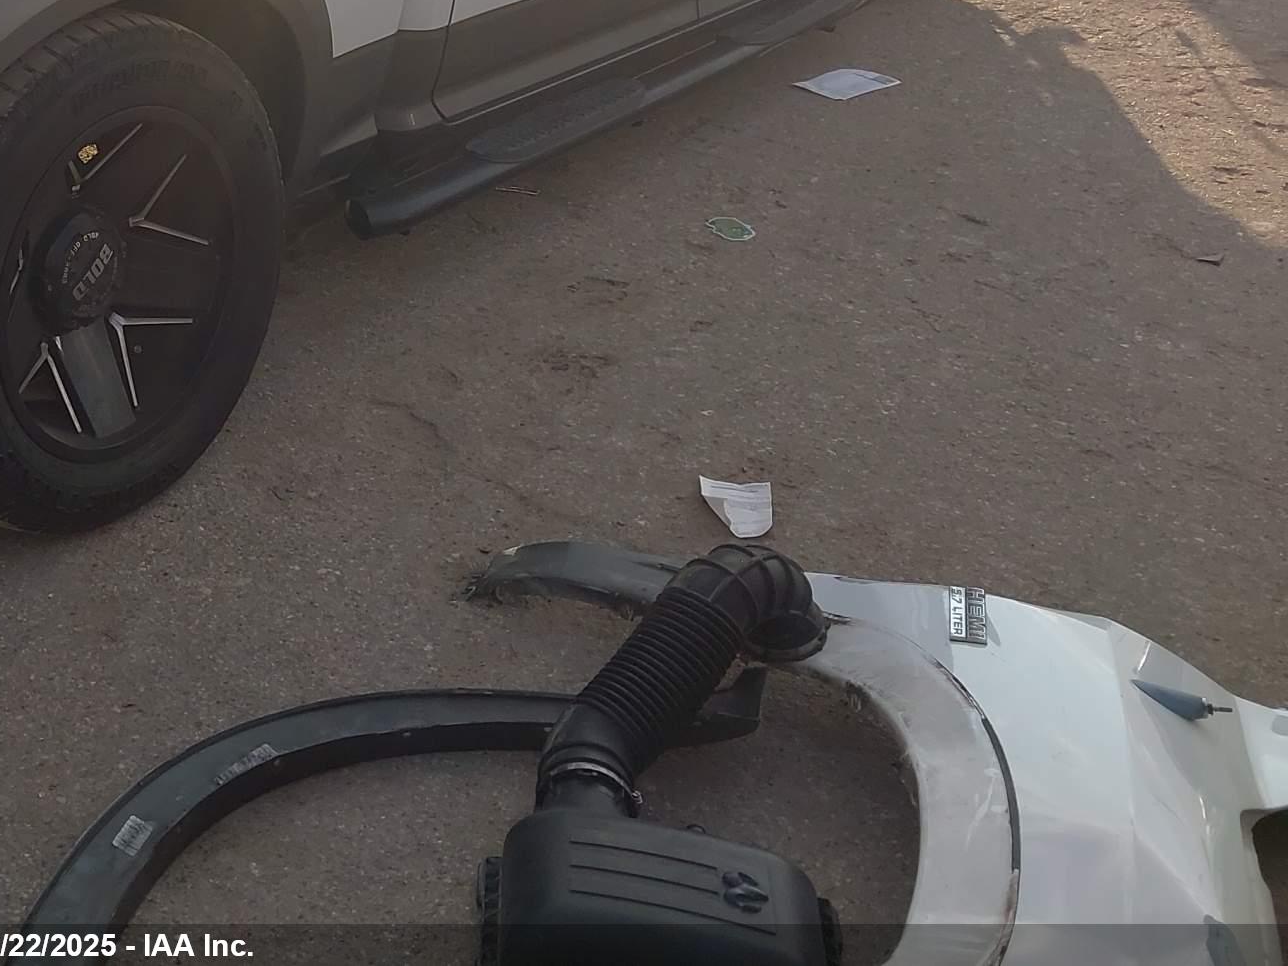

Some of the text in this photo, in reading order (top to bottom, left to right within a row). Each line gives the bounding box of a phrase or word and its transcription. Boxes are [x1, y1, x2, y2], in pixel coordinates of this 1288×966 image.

[72, 243, 114, 301] BOLD
[951, 607, 963, 636] LITER
[967, 587, 985, 640] HEMI
